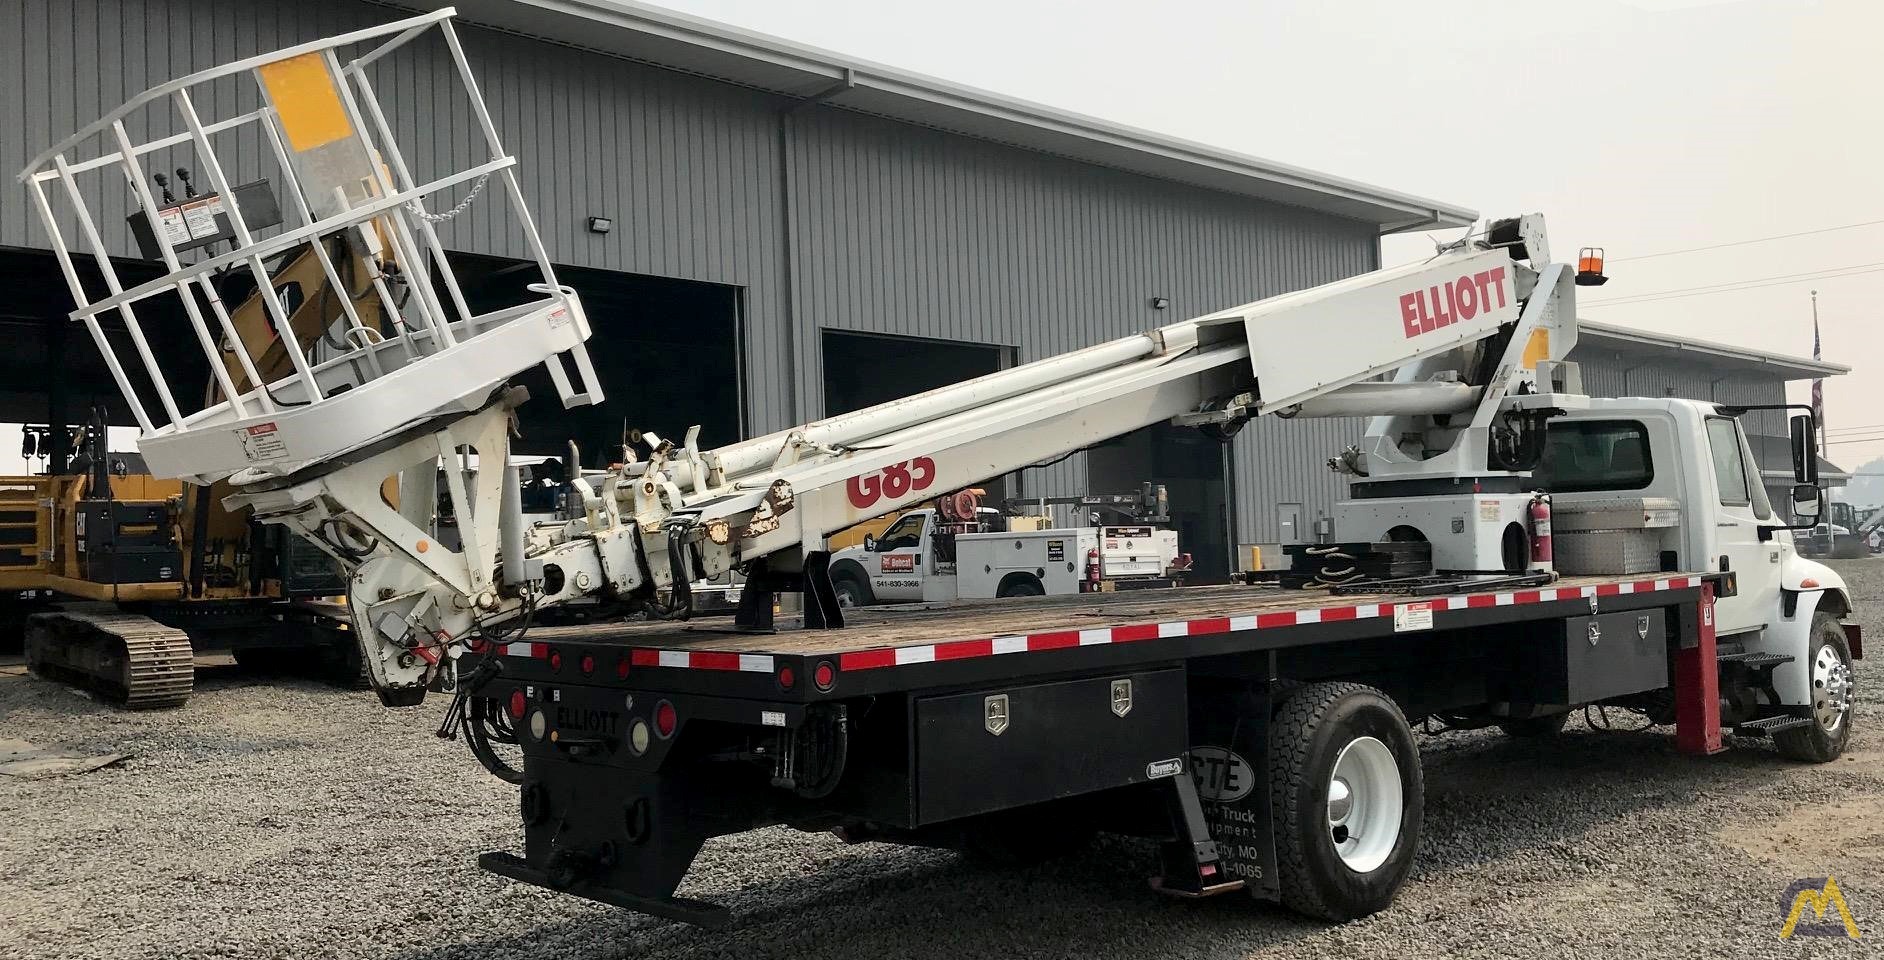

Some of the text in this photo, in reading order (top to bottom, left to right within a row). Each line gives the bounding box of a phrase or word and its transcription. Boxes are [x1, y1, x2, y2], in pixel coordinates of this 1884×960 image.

[1400, 266, 1505, 339] ELLIOTT
[847, 456, 935, 508] G85
[891, 558, 911, 567] Bobcat
[558, 706, 619, 734] ELLIOTT
[1222, 806, 1256, 824] Truck
[1211, 822, 1256, 839] ipment
[1238, 844, 1258, 860] MO
